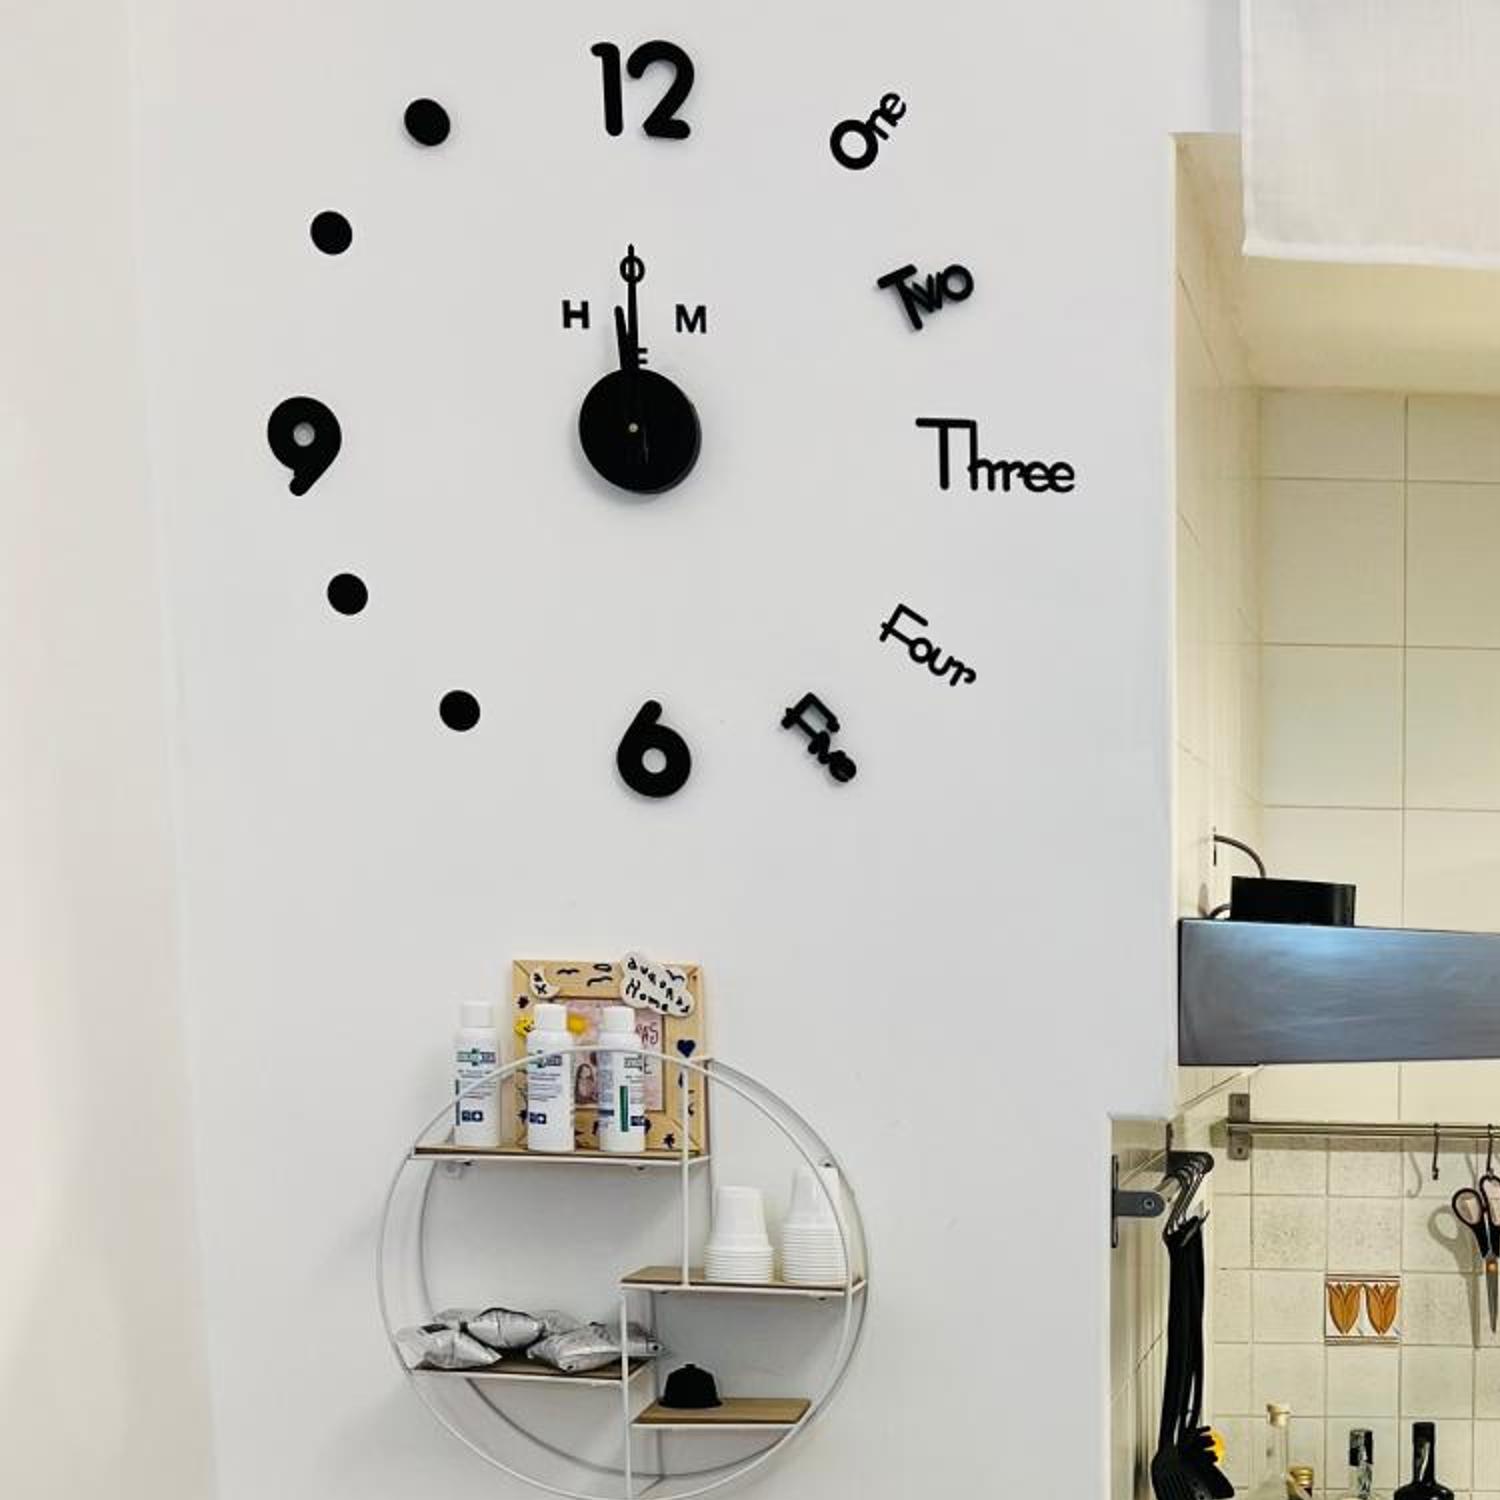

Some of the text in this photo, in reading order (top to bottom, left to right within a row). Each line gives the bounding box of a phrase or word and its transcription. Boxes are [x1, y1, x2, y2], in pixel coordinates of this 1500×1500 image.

[590, 40, 695, 140] 12
[829, 92, 907, 171] One
[876, 263, 975, 332] Two
[266, 396, 343, 497] 9
[915, 417, 1075, 494] Three
[879, 603, 977, 687] Four
[615, 699, 693, 800] 6
